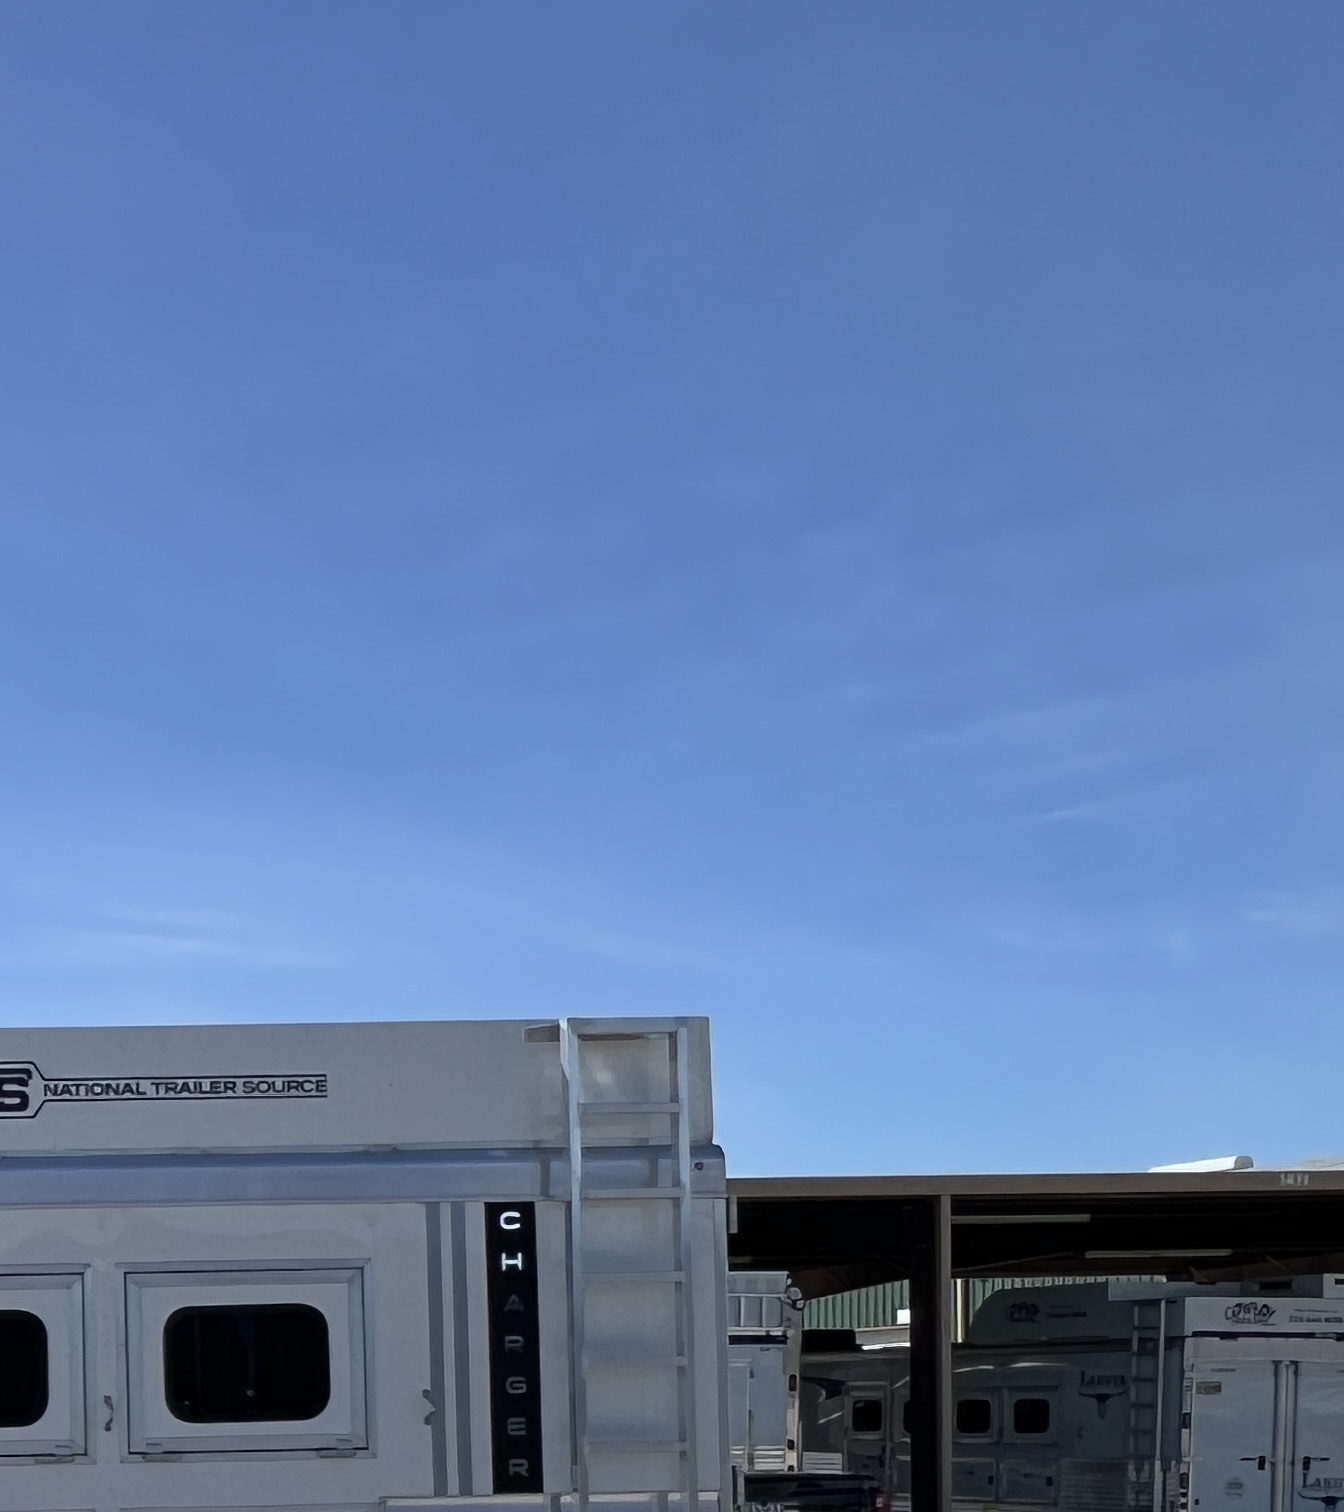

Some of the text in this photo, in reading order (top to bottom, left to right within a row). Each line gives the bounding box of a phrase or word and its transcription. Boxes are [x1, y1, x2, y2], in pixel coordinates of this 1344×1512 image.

[43, 1078, 329, 1098] NATIONAL TRAILER SOURCE
[499, 1211, 530, 1478] CHARGER
